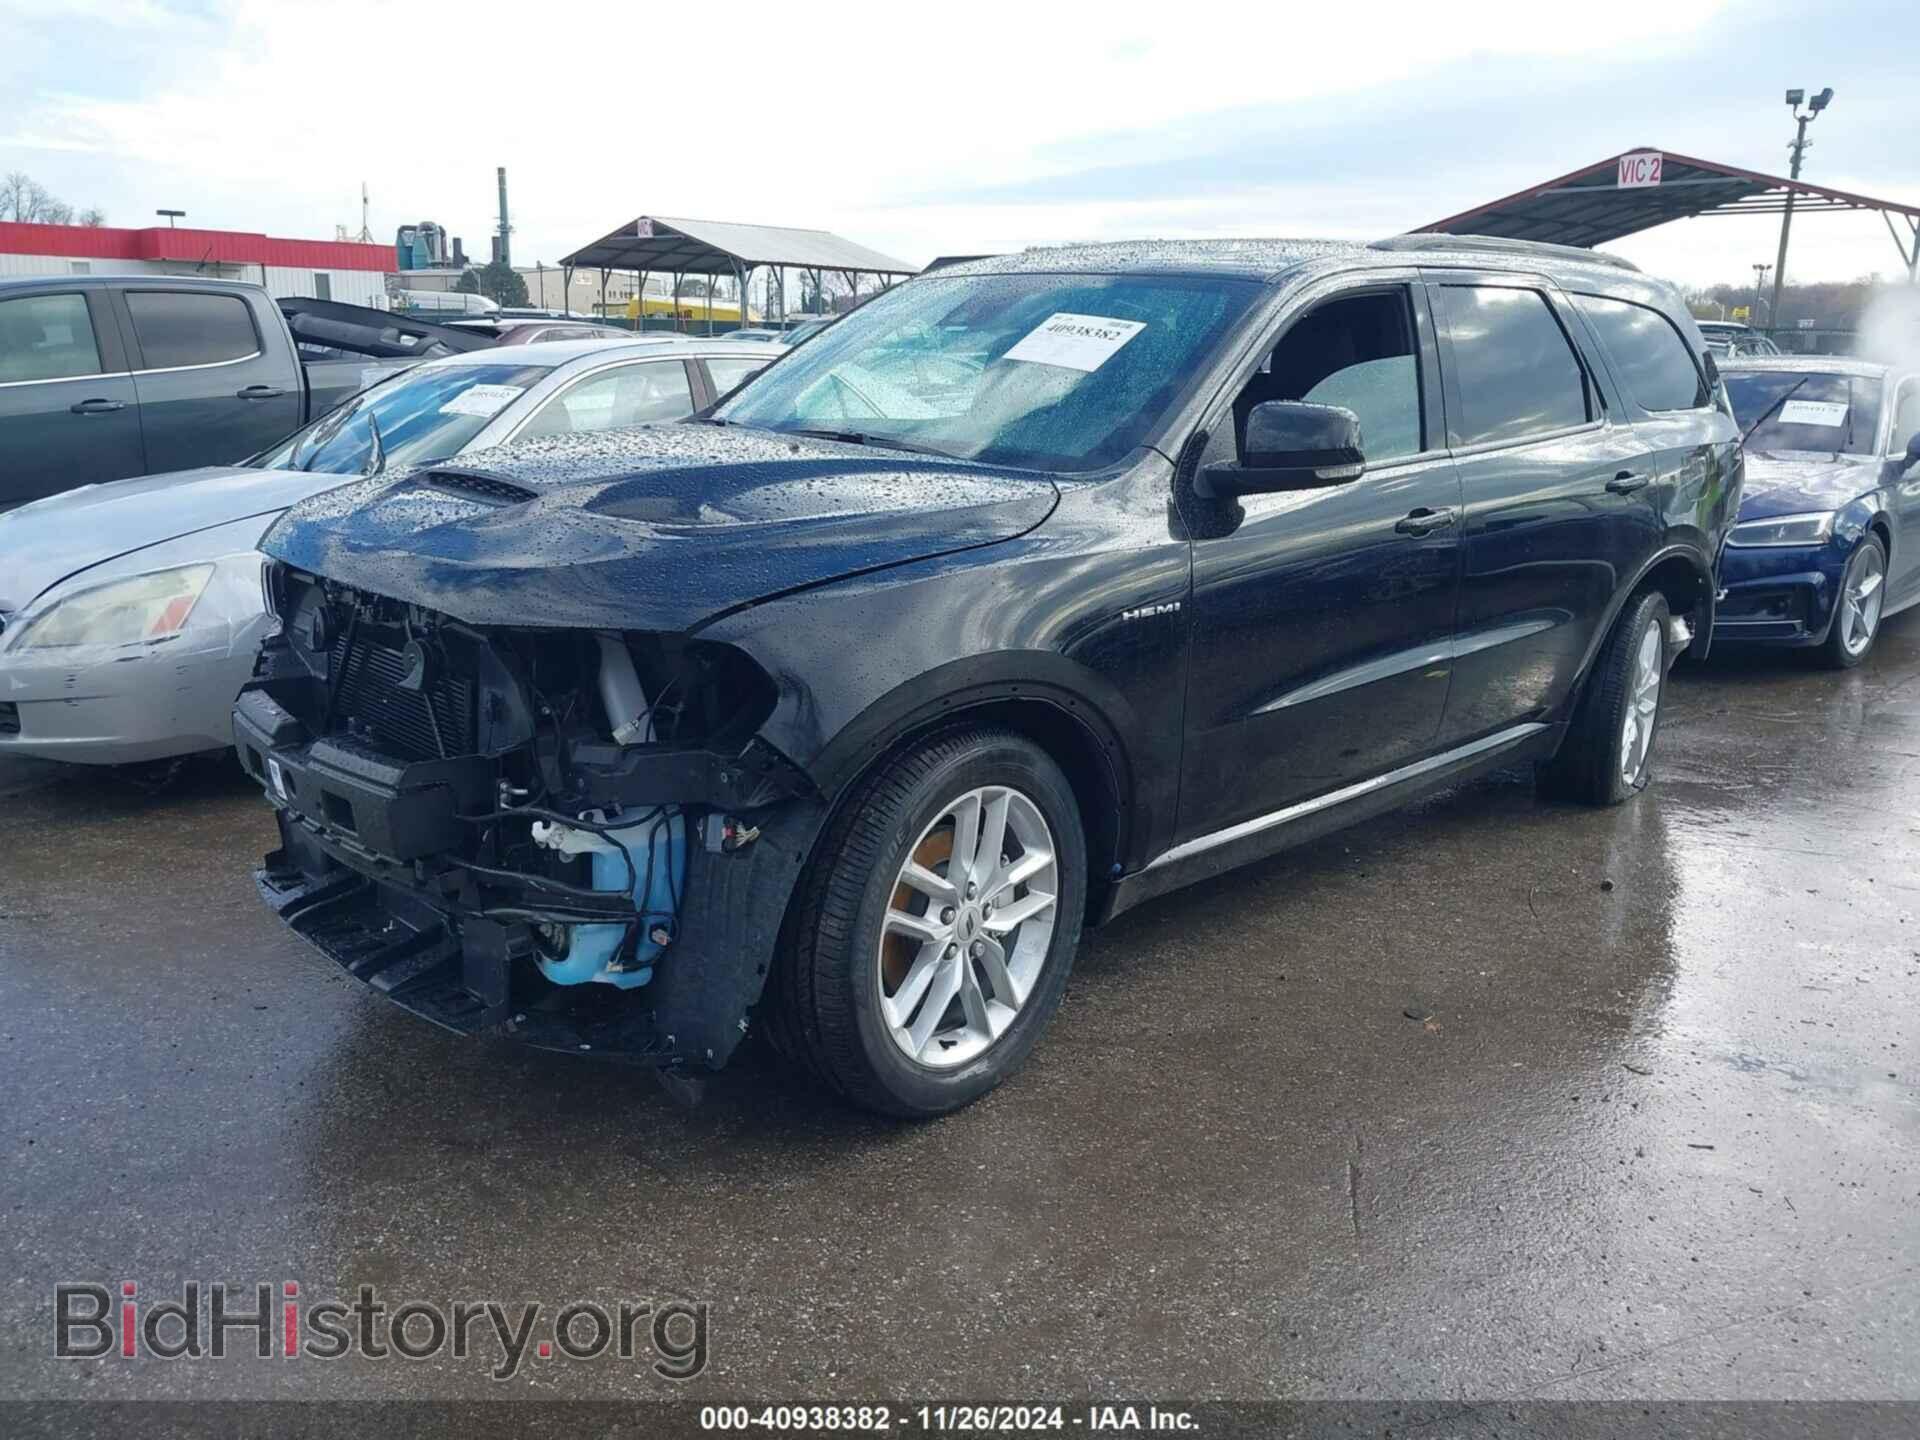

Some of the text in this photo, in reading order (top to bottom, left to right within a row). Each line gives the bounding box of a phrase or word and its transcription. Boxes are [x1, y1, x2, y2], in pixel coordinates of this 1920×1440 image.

[1620, 157, 1660, 184] VIC 2
[1046, 323, 1121, 341] 40938382
[1122, 602, 1181, 621] HEMI
